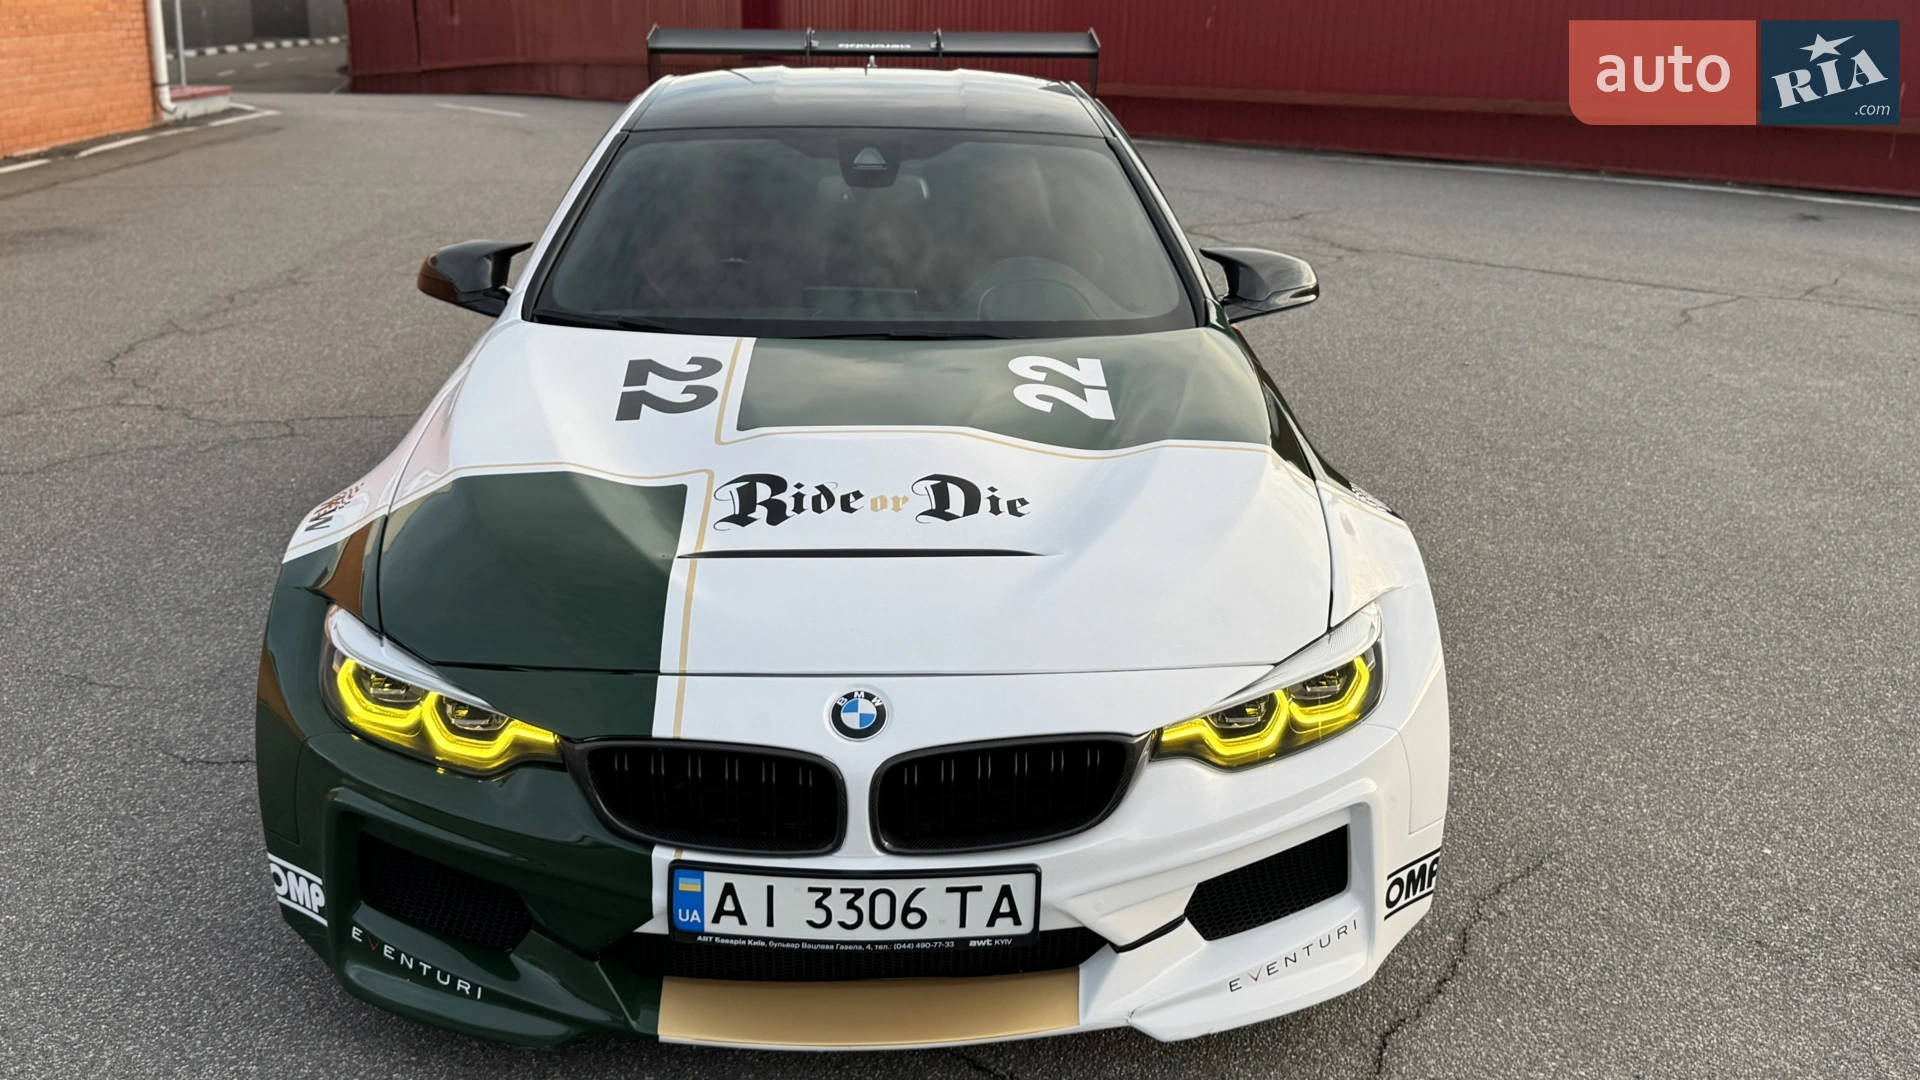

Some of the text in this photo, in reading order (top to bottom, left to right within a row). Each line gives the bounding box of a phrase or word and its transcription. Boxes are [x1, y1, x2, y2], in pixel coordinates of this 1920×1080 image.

[615, 356, 723, 422] 22
[1008, 355, 1115, 421] 22
[713, 473, 1031, 531] Ride or Die
[836, 691, 883, 707] BMW
[270, 862, 325, 913] OMP
[711, 882, 1022, 930] AI 3306 TA
[1385, 856, 1440, 909] OMP
[678, 908, 702, 924] UA
[352, 926, 482, 999] EVENTURI
[893, 942, 914, 950] (044)
[915, 941, 955, 950] 490-77-33
[969, 938, 1013, 947] awt KYIV
[1229, 919, 1357, 992] EVENTURI
